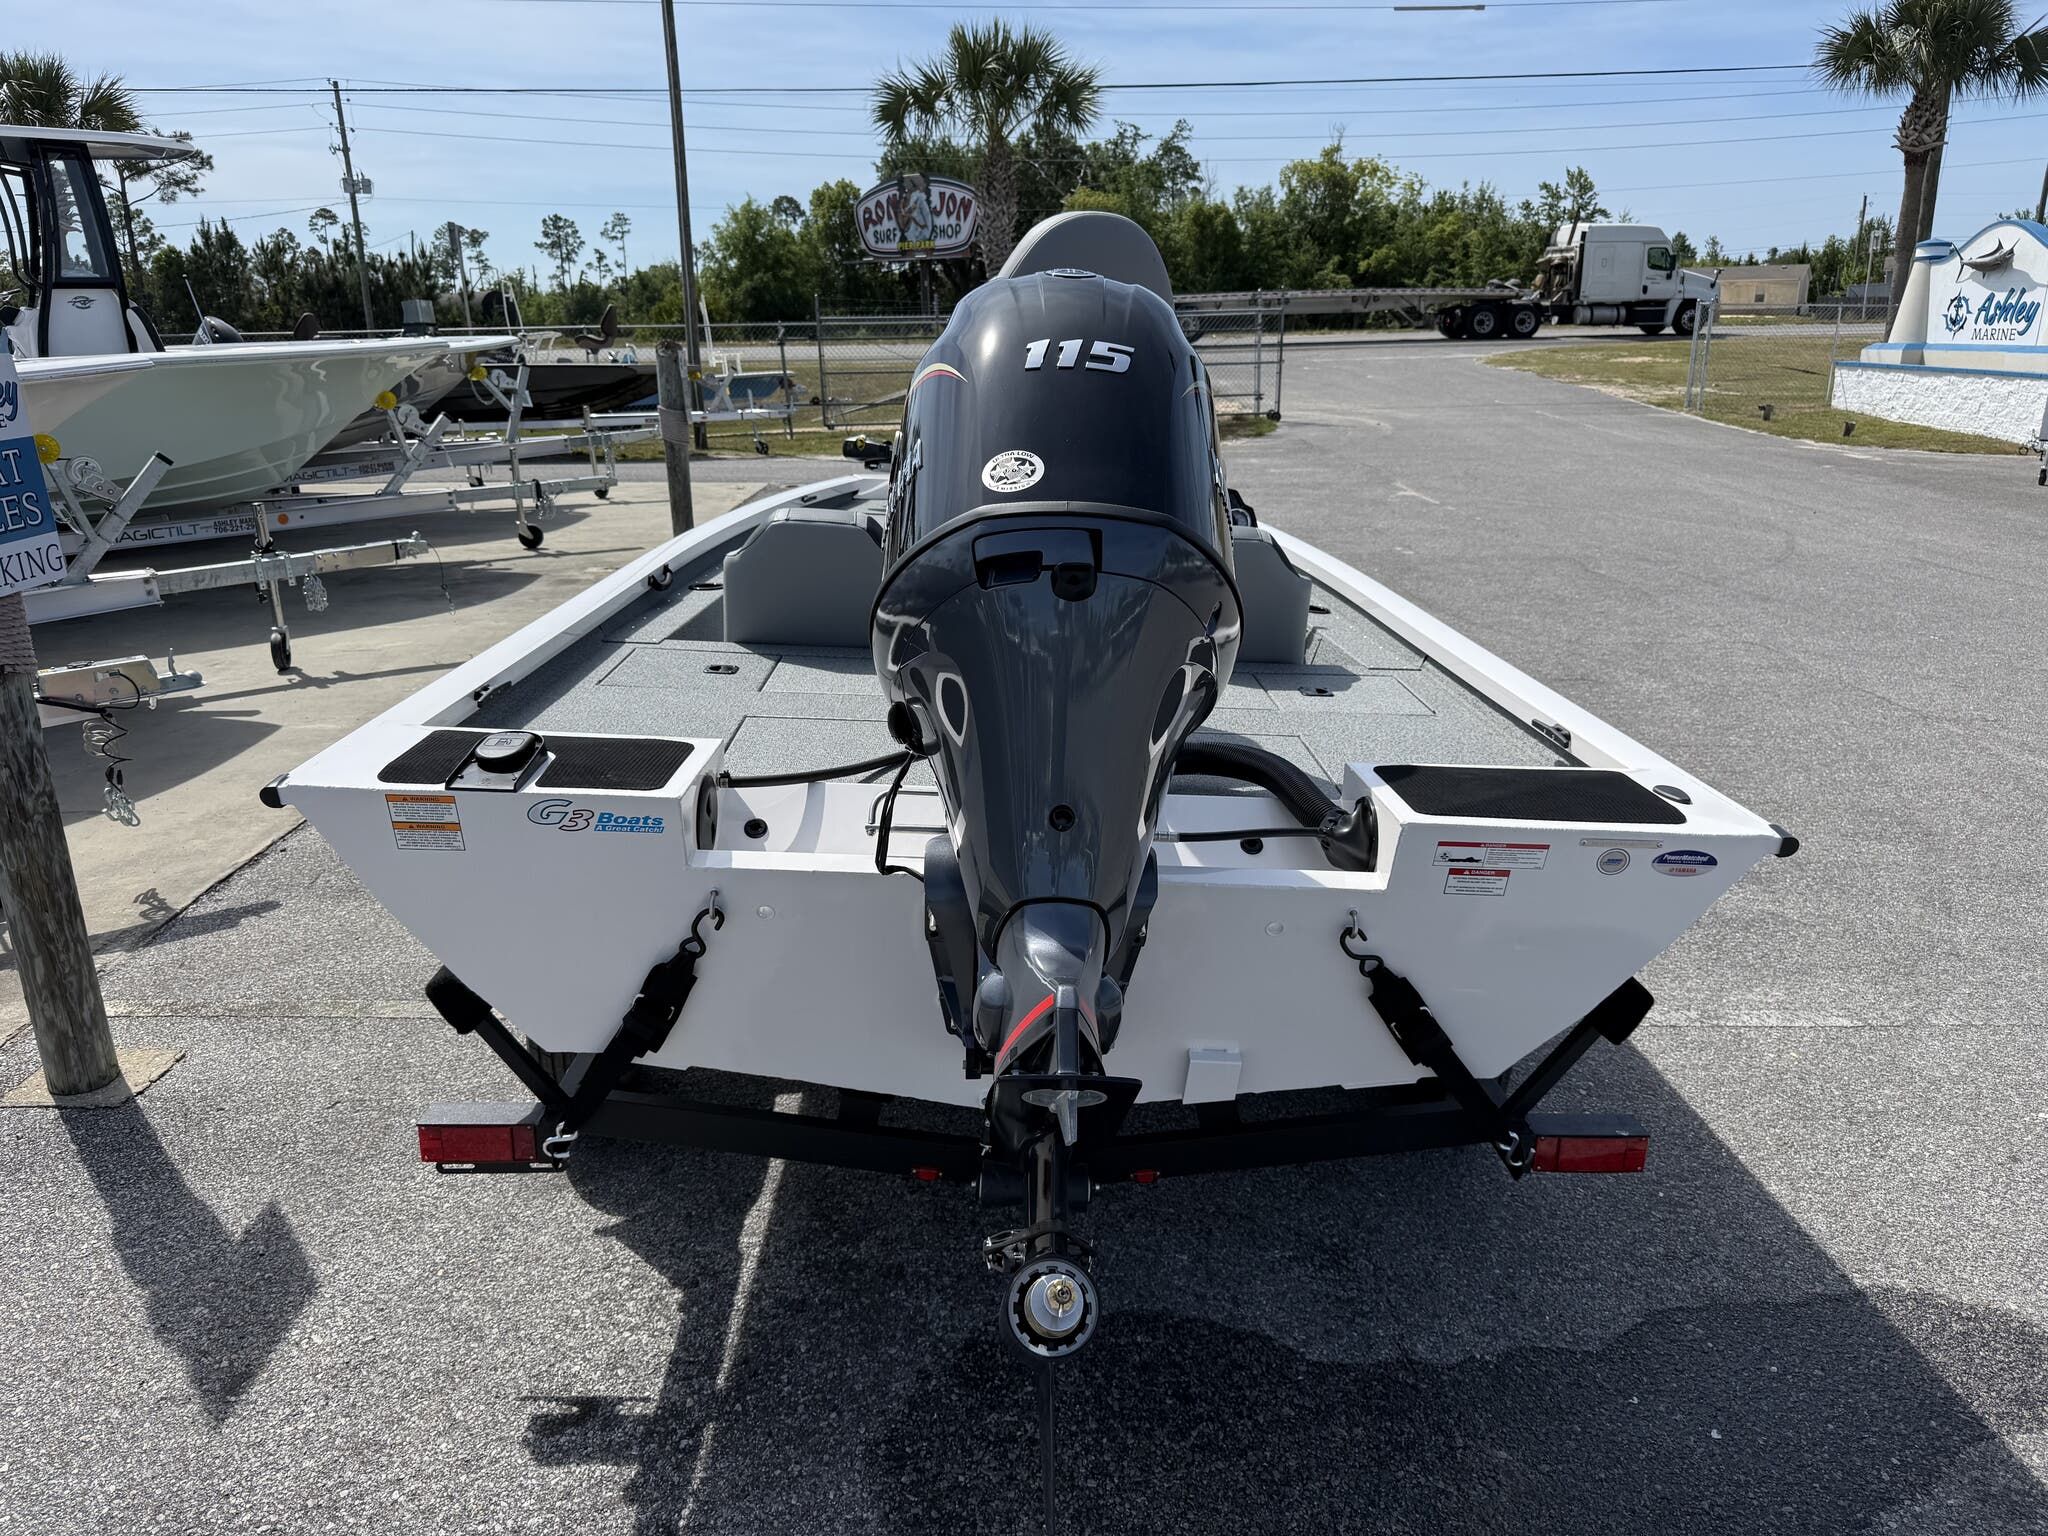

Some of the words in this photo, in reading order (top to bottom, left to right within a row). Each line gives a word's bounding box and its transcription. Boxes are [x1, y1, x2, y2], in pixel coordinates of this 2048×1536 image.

[863, 192, 899, 233] RON
[932, 192, 973, 223] JON
[873, 229, 898, 244] SURF
[933, 224, 962, 239] SHOP
[1974, 287, 2041, 336] Ashley
[1971, 328, 2017, 341] MARINE
[1024, 338, 1135, 373] 115
[0, 492, 42, 532] ES
[115, 524, 200, 544] AGICTILT
[0, 544, 63, 588] KING
[527, 798, 595, 832] G3
[596, 812, 664, 826] Boats
